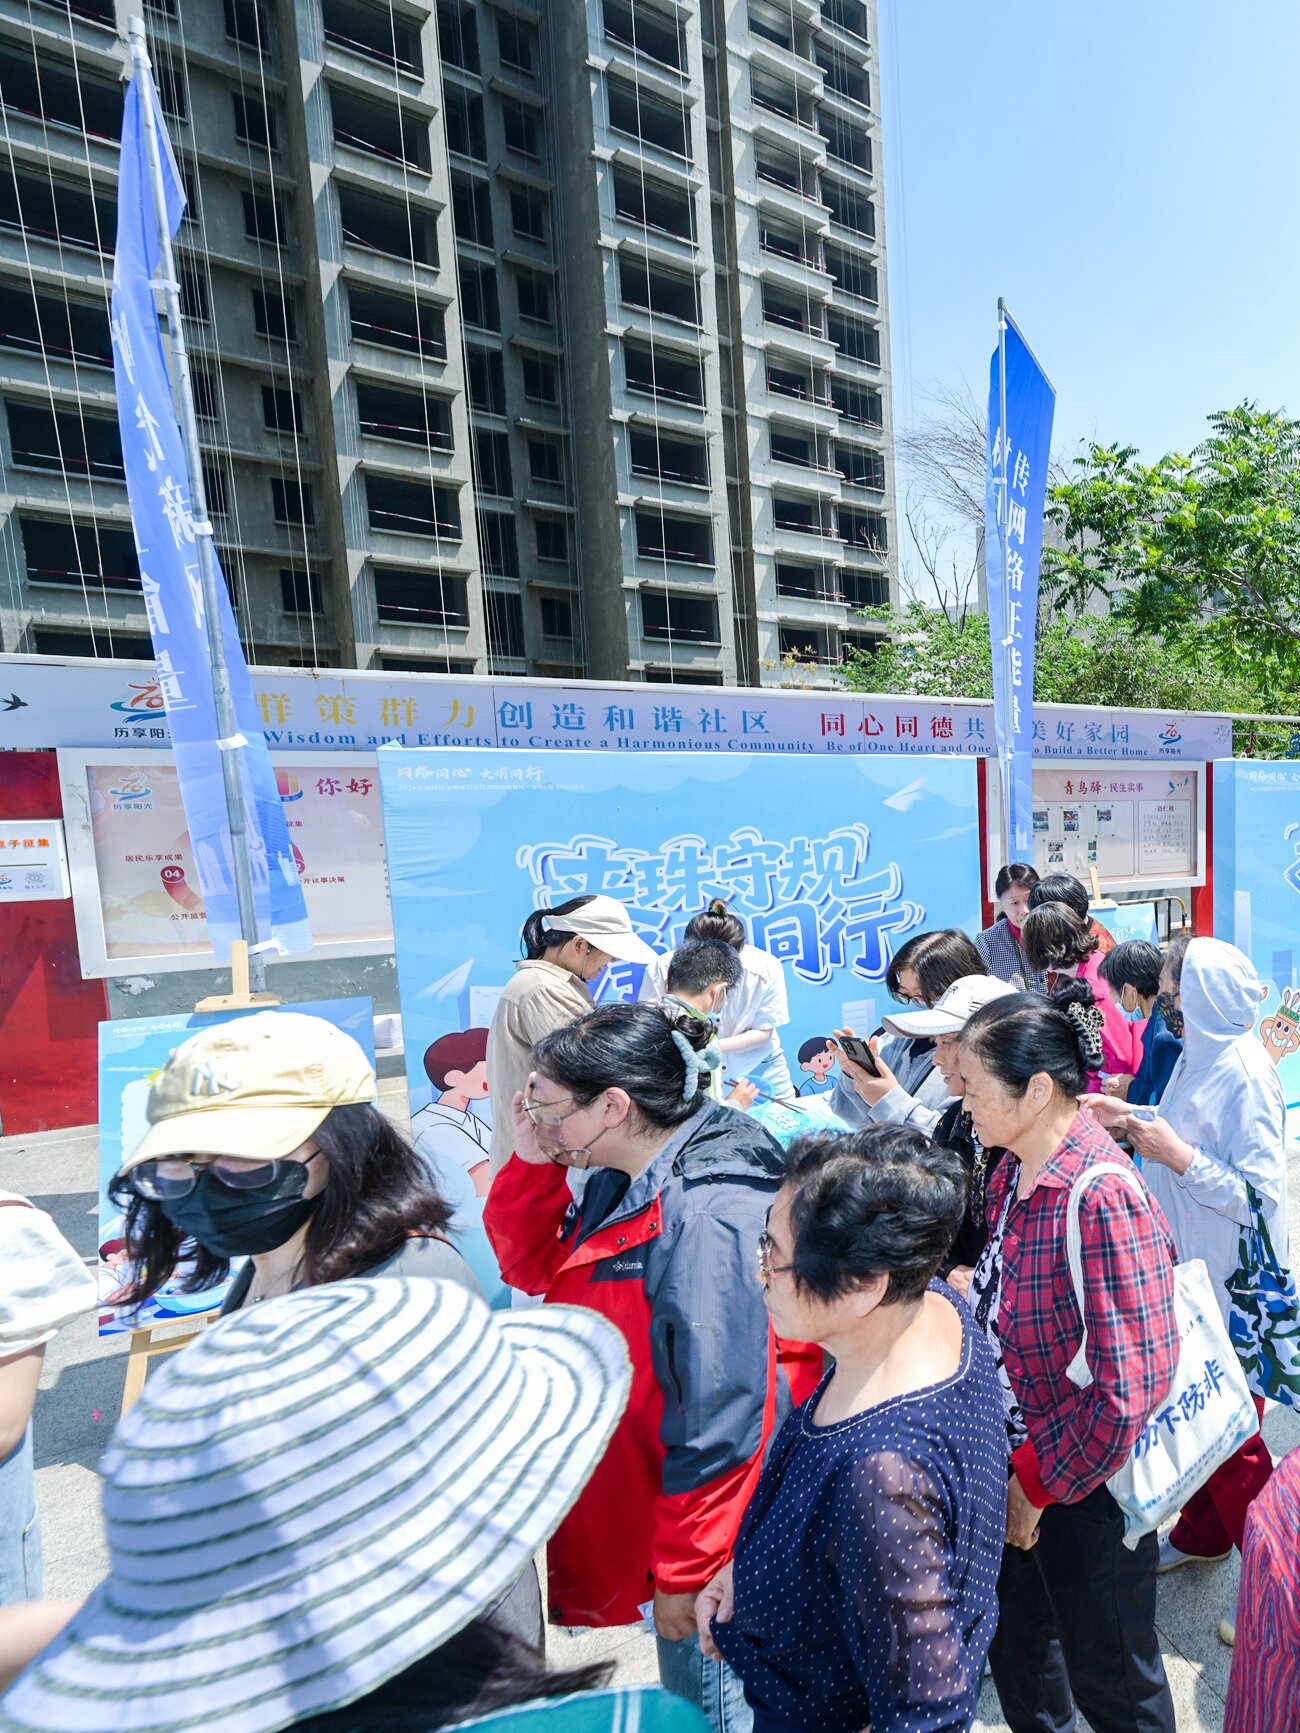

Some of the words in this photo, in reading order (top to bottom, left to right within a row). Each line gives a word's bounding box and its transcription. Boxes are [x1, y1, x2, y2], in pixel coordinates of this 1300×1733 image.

[256, 692, 475, 729] 群策群力
[497, 700, 770, 735] 创造和谐社区
[820, 712, 954, 739] 同心同德
[113, 727, 172, 739] 历享阳
[263, 730, 356, 745] Wisdom
[367, 733, 407, 746] and
[418, 732, 491, 747] Efforts
[502, 736, 519, 747] to
[528, 735, 592, 748] Create
[600, 739, 609, 748] a
[617, 737, 721, 750] Harmonious
[727, 738, 815, 753] Community
[827, 741, 843, 751] Be
[849, 741, 862, 752] of
[868, 741, 894, 752] One
[900, 742, 936, 753] Heart
[941, 743, 963, 753] and
[968, 743, 992, 753] One
[1045, 745, 1073, 755] Build
[1087, 746, 1119, 756] Better
[1122, 747, 1149, 756] Home
[315, 777, 373, 798] 你好
[113, 803, 153, 811] 历享阳光
[164, 870, 181, 879] 04
